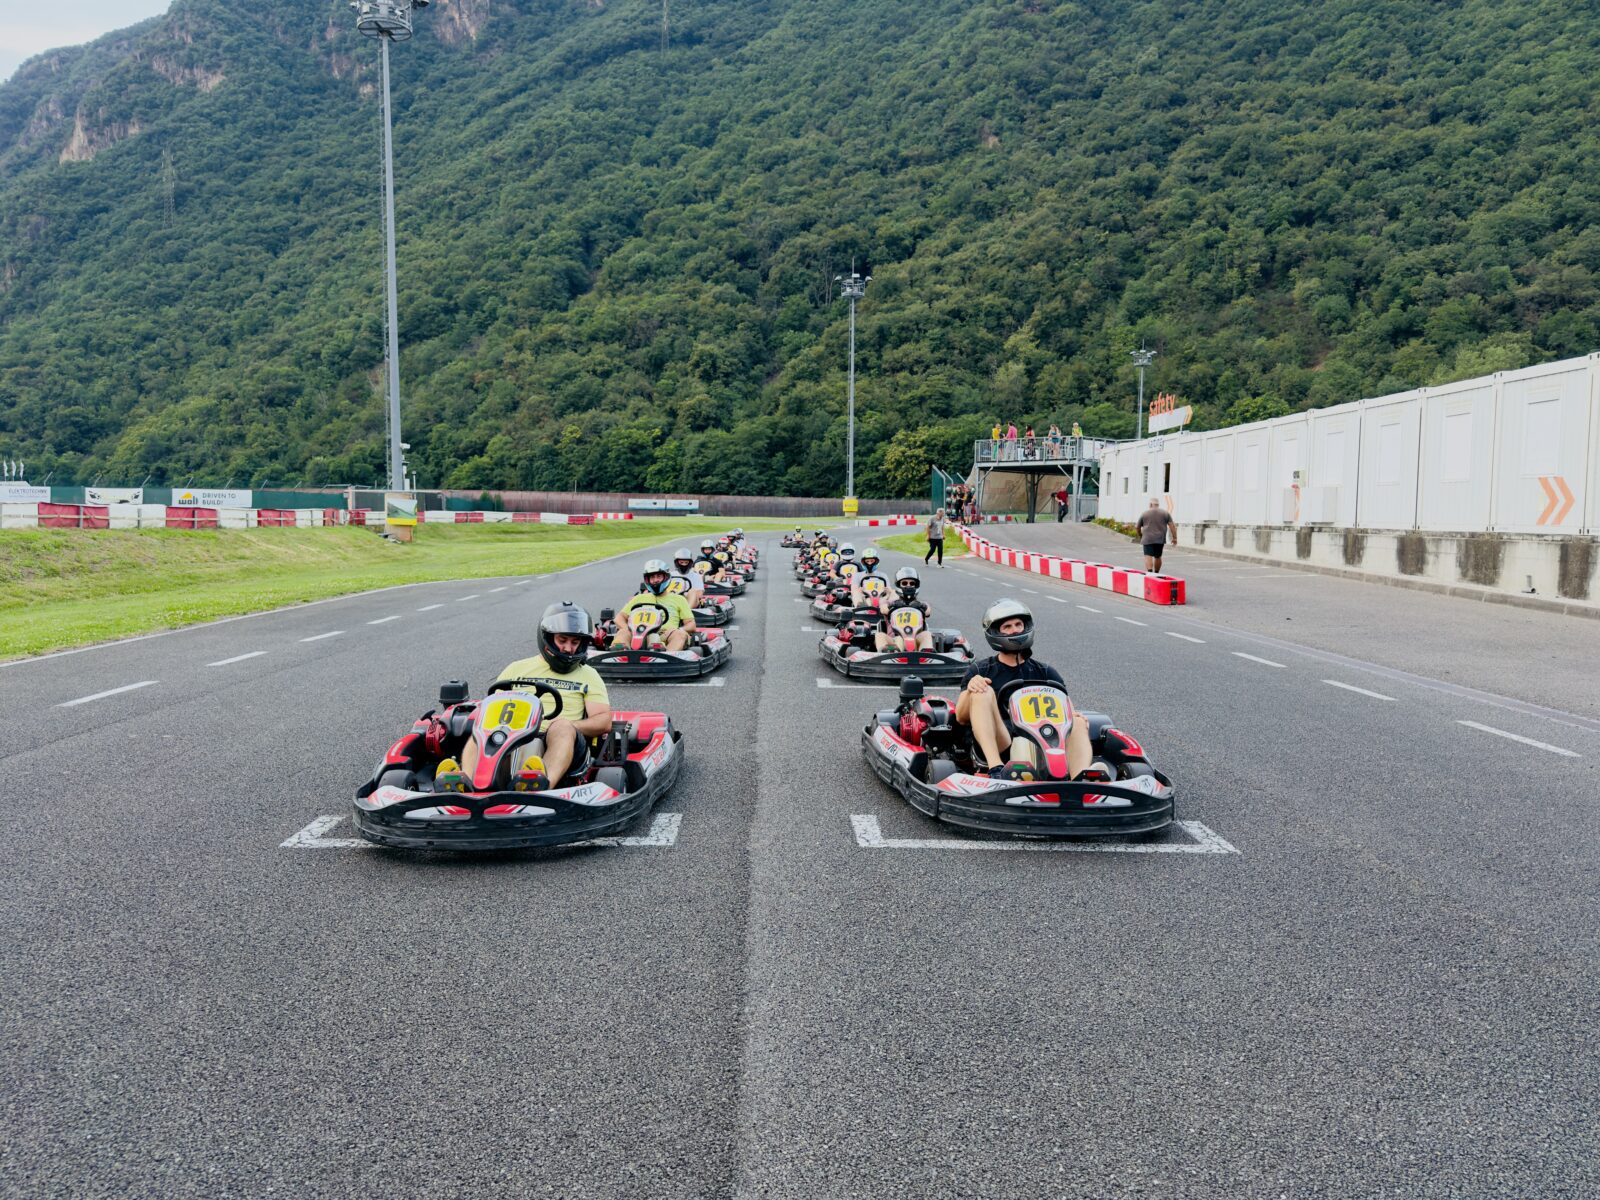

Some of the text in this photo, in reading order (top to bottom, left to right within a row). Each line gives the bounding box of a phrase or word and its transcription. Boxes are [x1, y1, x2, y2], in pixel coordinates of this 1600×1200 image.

[1149, 391, 1176, 417] safety
[637, 612, 652, 622] 11
[896, 612, 911, 624] 13
[498, 702, 516, 725] 6
[1028, 695, 1059, 719] 12
